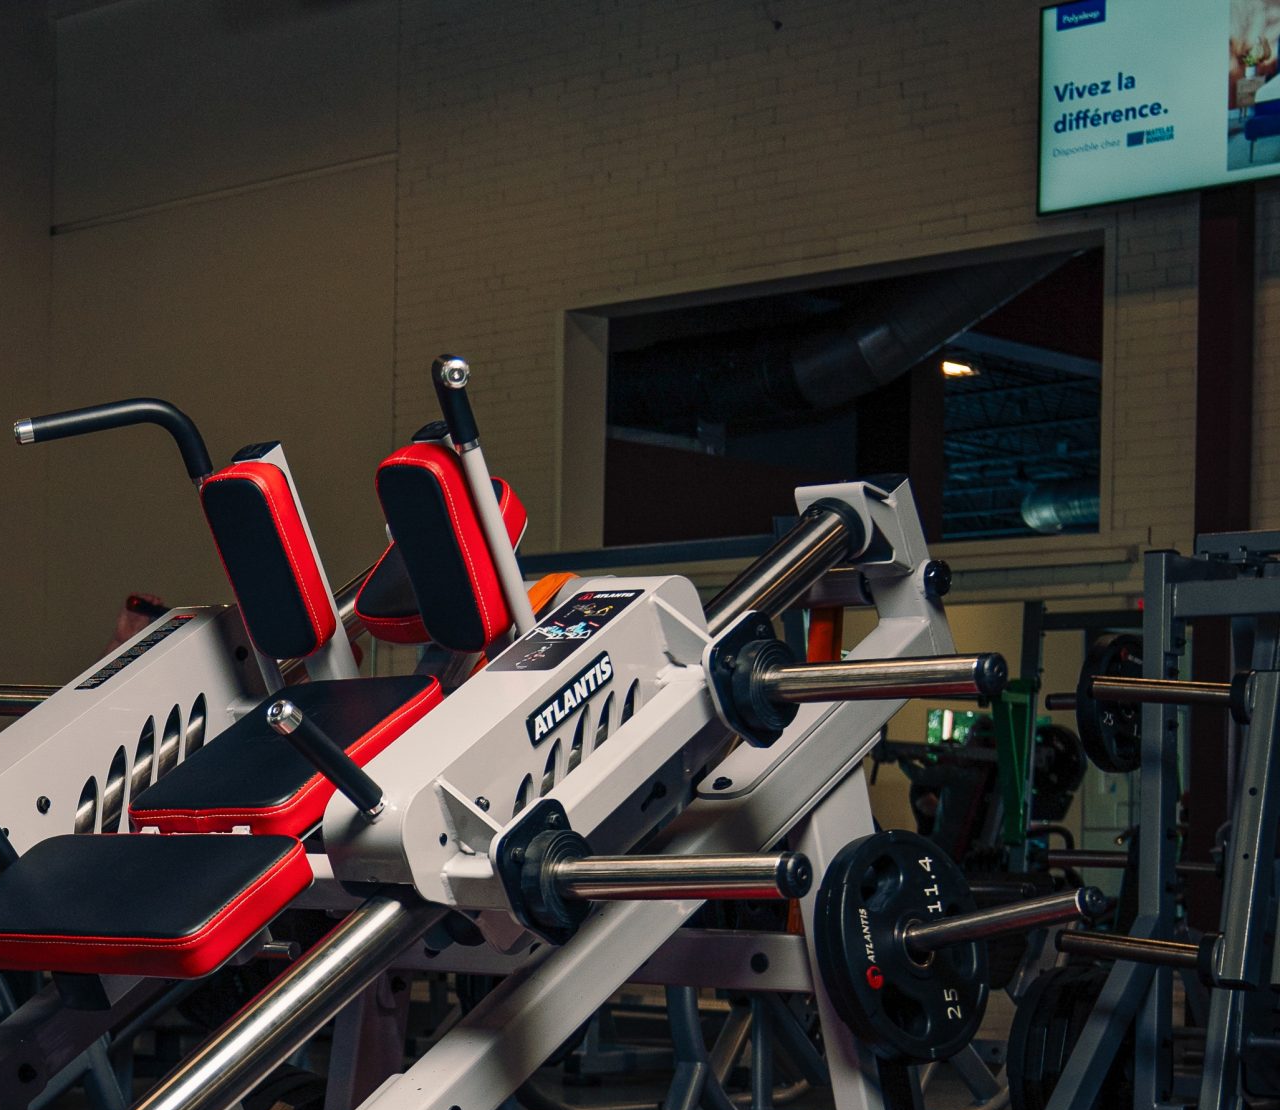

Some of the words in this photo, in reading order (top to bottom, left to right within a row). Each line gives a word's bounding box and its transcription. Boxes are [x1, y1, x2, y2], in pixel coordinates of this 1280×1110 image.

[1053, 81, 1111, 103] Vivez
[1117, 72, 1136, 91] la
[1053, 102, 1169, 134] différence.
[534, 655, 612, 741] ATLANTIS
[1103, 711, 1115, 726] 25
[918, 856, 943, 913] 11.4
[858, 908, 877, 963] ATLANTIS
[943, 988, 963, 1020] 25
